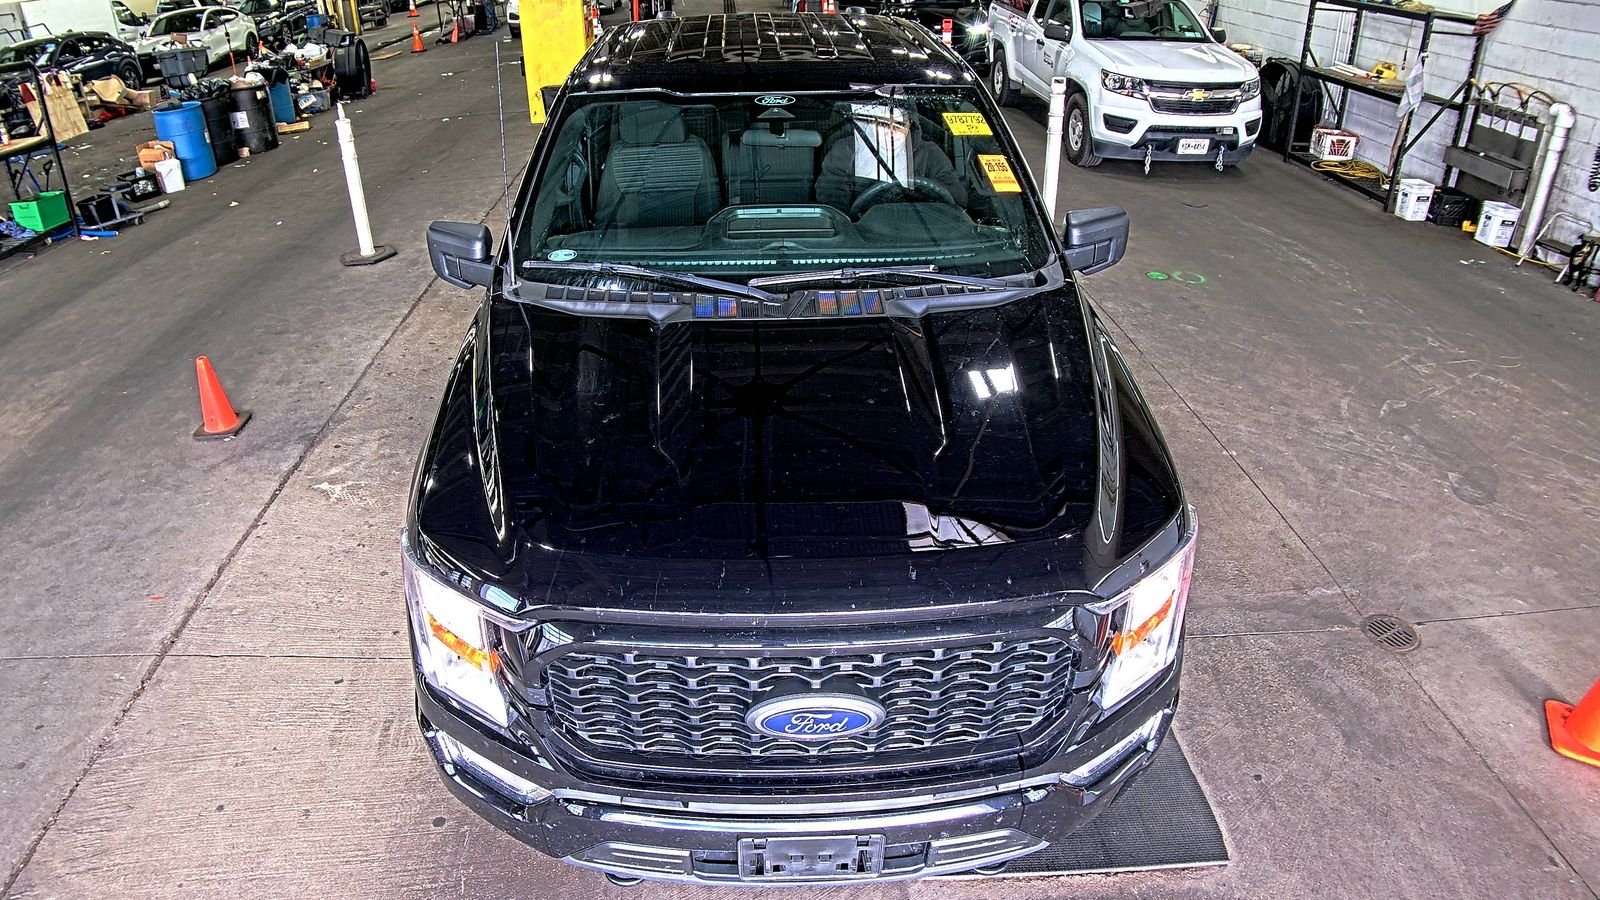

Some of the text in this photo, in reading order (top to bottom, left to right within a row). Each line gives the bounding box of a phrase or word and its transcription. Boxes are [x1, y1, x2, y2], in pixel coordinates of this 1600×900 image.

[762, 95, 789, 104] Ford
[945, 115, 986, 124] 9787792
[784, 713, 849, 733] Ford
